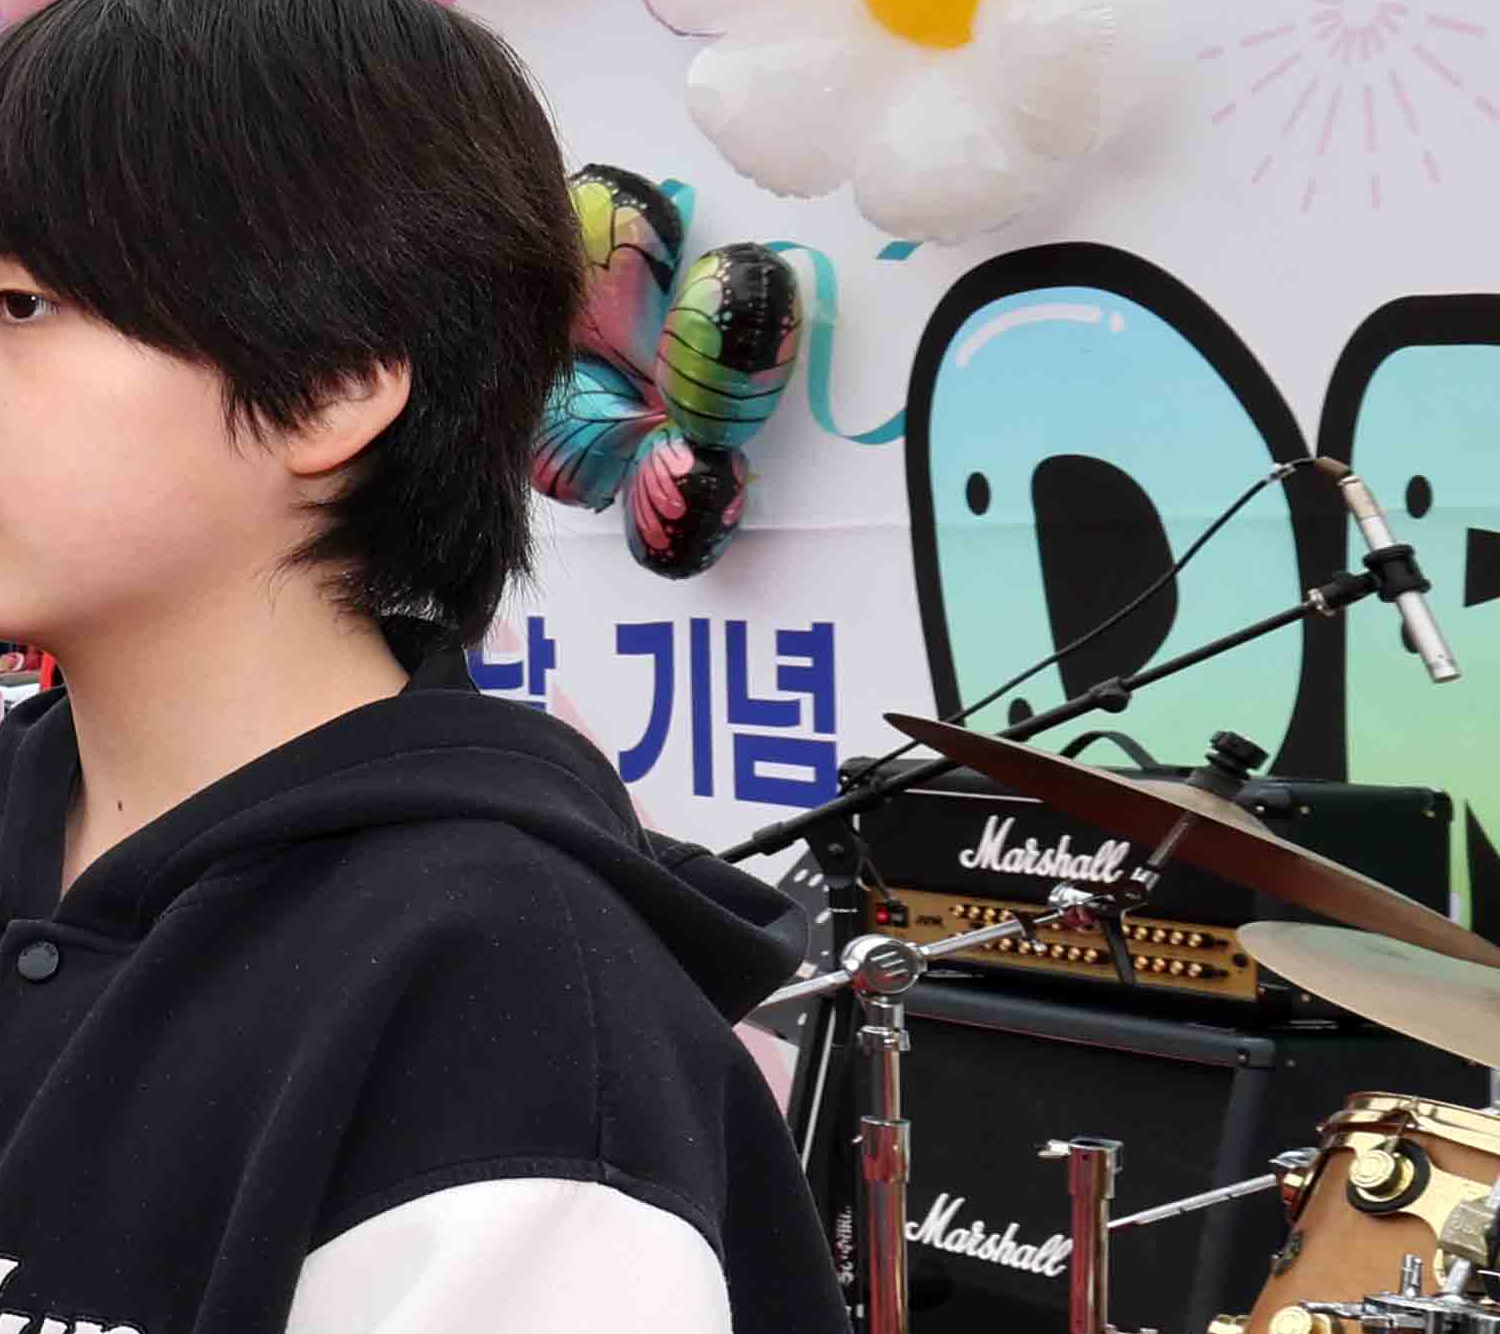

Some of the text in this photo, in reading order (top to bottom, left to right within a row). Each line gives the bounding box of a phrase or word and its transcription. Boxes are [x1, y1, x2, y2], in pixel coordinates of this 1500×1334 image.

[616, 617, 838, 809] 기념
[959, 815, 1132, 883] Marshall
[905, 1192, 1074, 1278] Marshall
